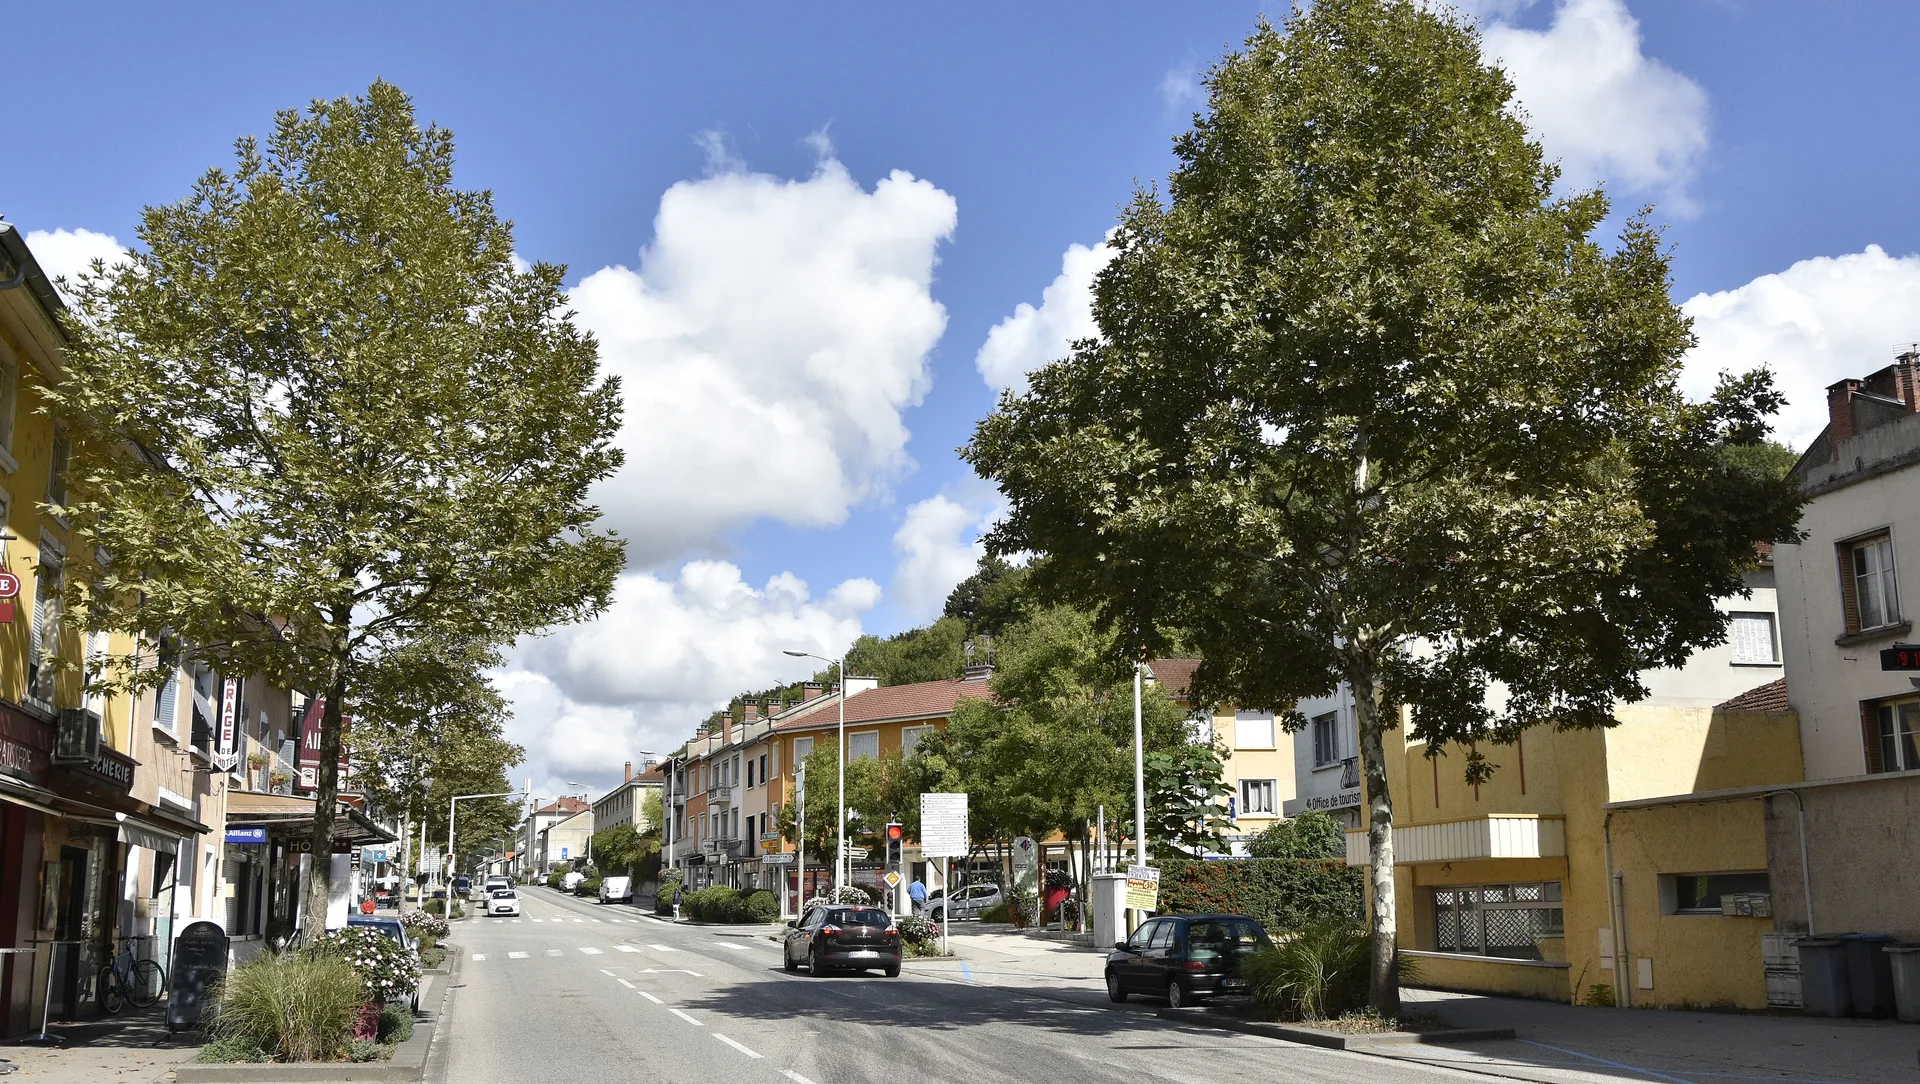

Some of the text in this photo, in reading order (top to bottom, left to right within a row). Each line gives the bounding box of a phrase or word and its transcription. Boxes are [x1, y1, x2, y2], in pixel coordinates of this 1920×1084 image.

[221, 747, 231, 755] DE
[1312, 791, 1361, 810] Office de touris
